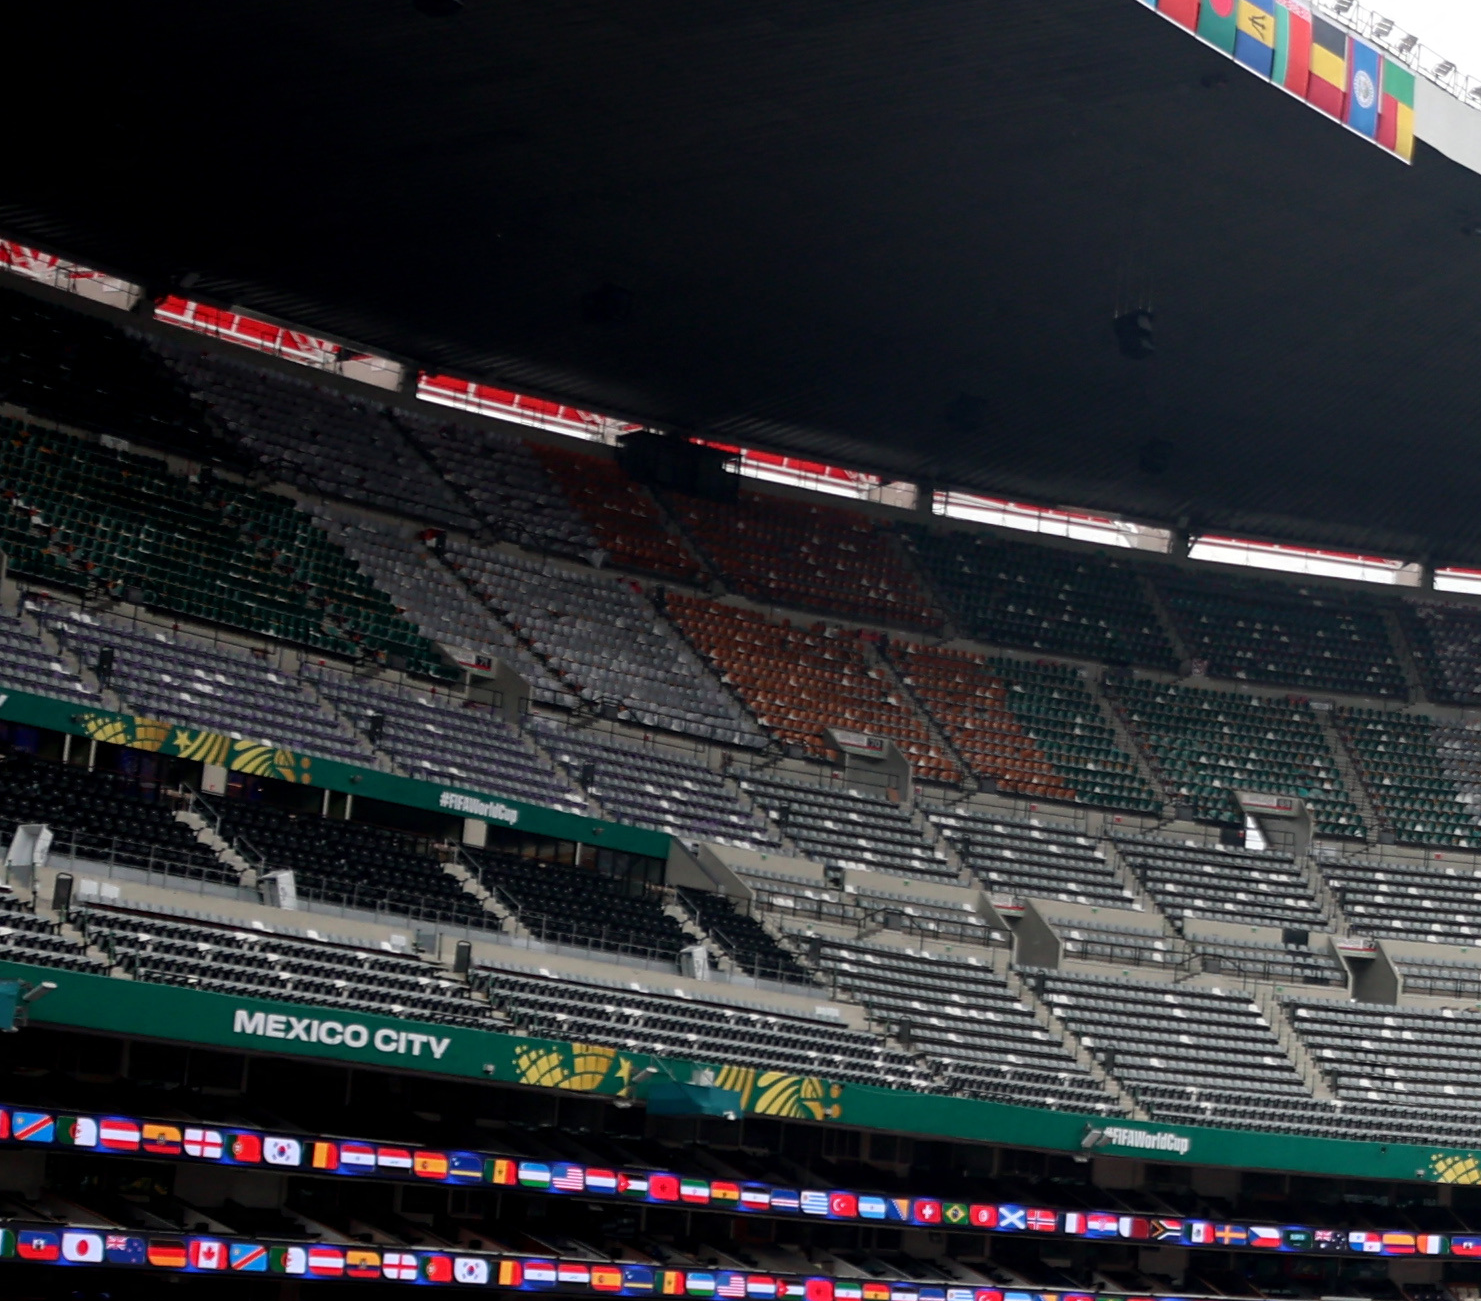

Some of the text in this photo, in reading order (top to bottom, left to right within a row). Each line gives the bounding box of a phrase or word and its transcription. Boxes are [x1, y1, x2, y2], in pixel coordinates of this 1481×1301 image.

[439, 792, 519, 825] #FIFAWorldCup
[233, 1010, 451, 1059] MEXICO CITY
[1104, 1126, 1190, 1155] #FIFAWorldCup
